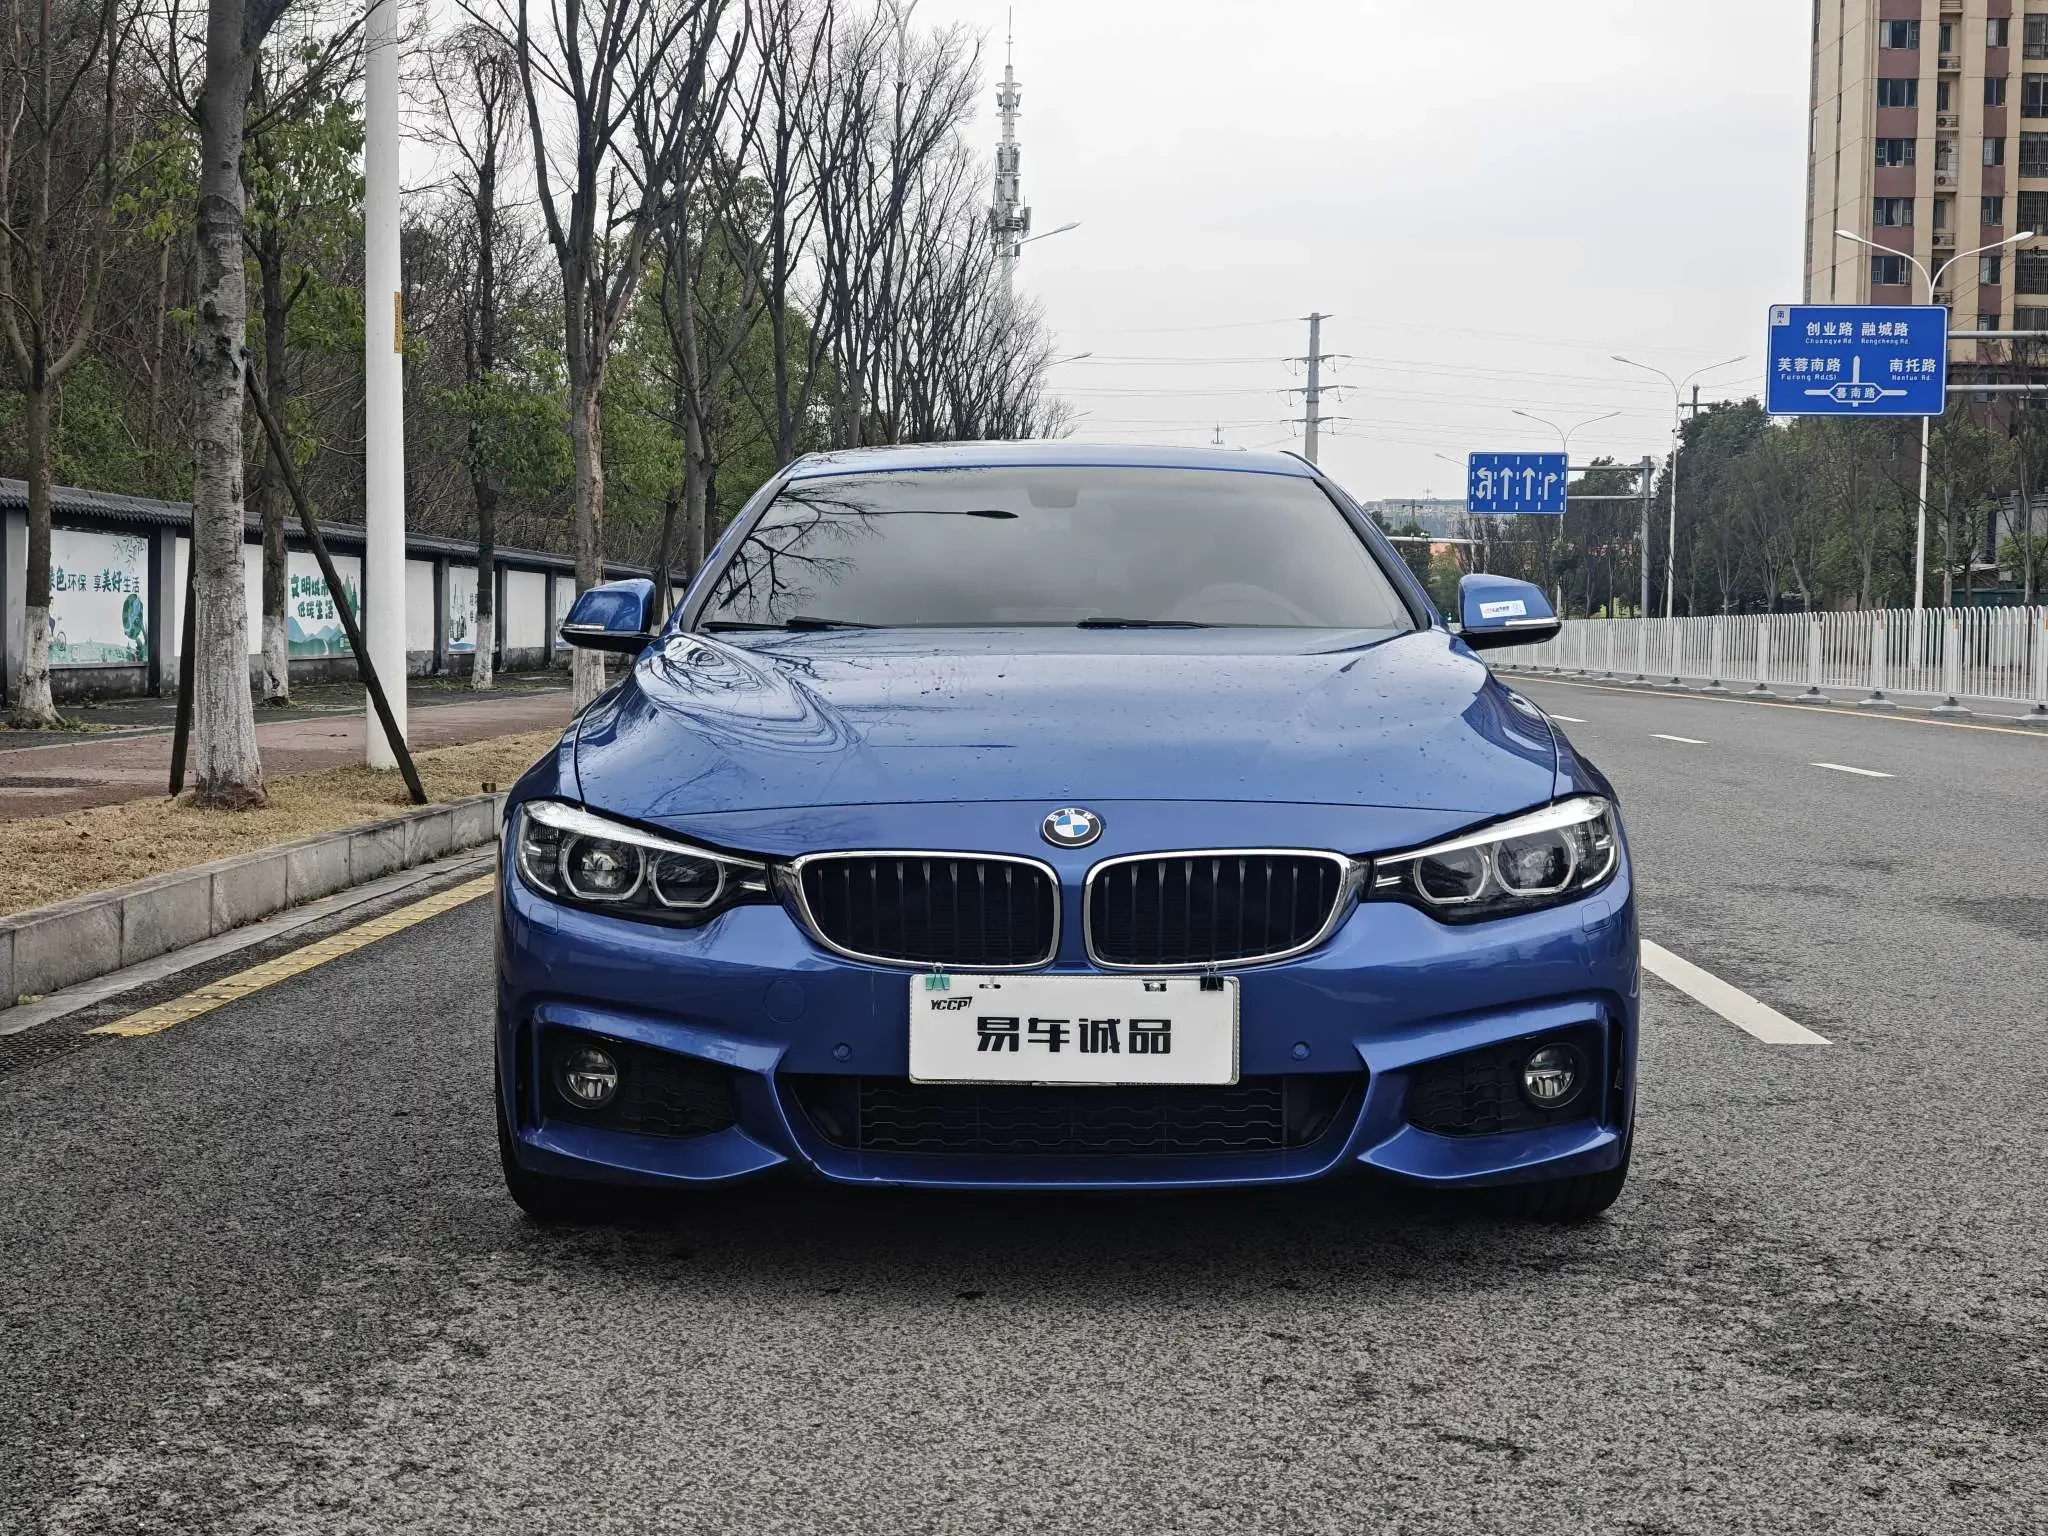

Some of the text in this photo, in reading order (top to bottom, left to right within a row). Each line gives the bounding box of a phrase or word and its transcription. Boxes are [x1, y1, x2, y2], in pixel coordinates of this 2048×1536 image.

[1806, 321, 1909, 337] 创业路 融城路
[1861, 338, 1898, 346] Rongcheng
[1778, 357, 1841, 372] 芙蓉南路
[1889, 358, 1936, 373] 南托路
[1781, 373, 1812, 382] Furong
[93, 568, 140, 593] 享美好生活
[297, 600, 334, 620] 低碳生活
[1047, 808, 1096, 821] BMW
[930, 996, 972, 1011] YCCP
[976, 1016, 1172, 1055] 易车诚品
